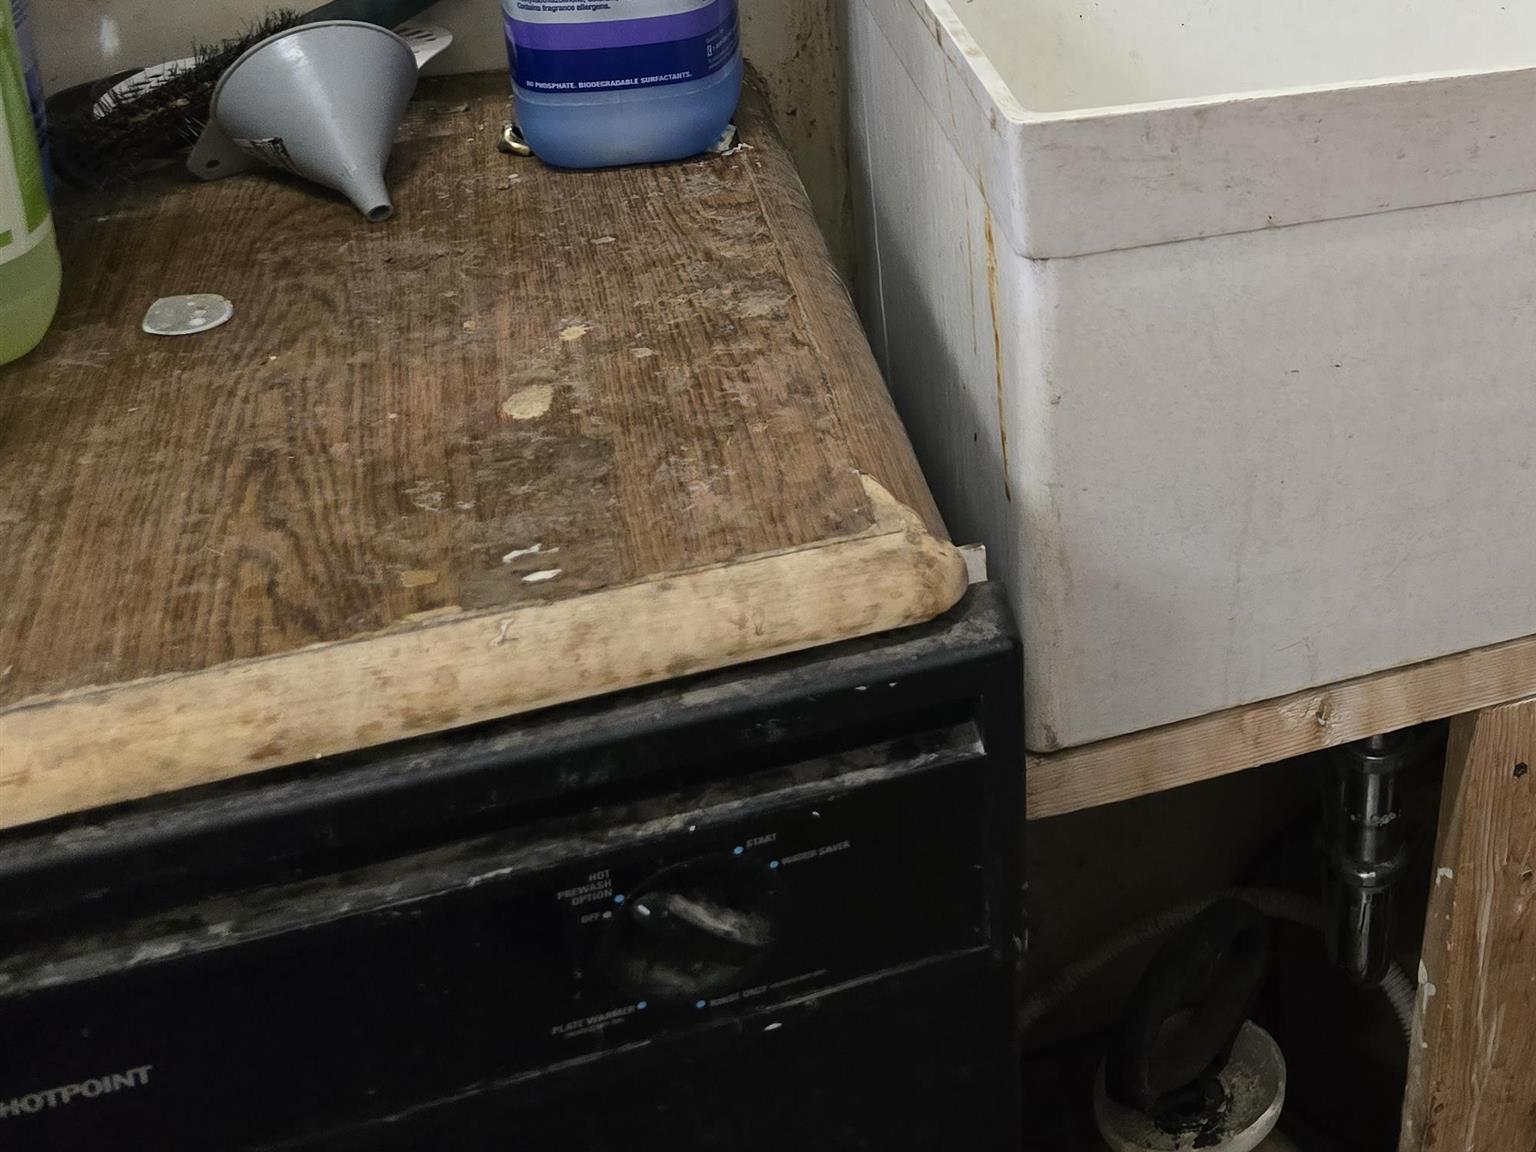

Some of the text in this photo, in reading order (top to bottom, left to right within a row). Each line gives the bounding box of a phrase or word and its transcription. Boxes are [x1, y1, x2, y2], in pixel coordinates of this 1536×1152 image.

[542, 3, 575, 12] fragrance
[578, 78, 638, 89] BIODEGRADABLE
[640, 71, 692, 84] SURFACTANTS.
[746, 833, 777, 847] START
[589, 869, 611, 881] HOT
[557, 879, 612, 900] PREWASH
[572, 889, 613, 906] OPTION
[552, 1019, 588, 1036] PLATE
[0, 1064, 154, 1120] HOTPOINT
